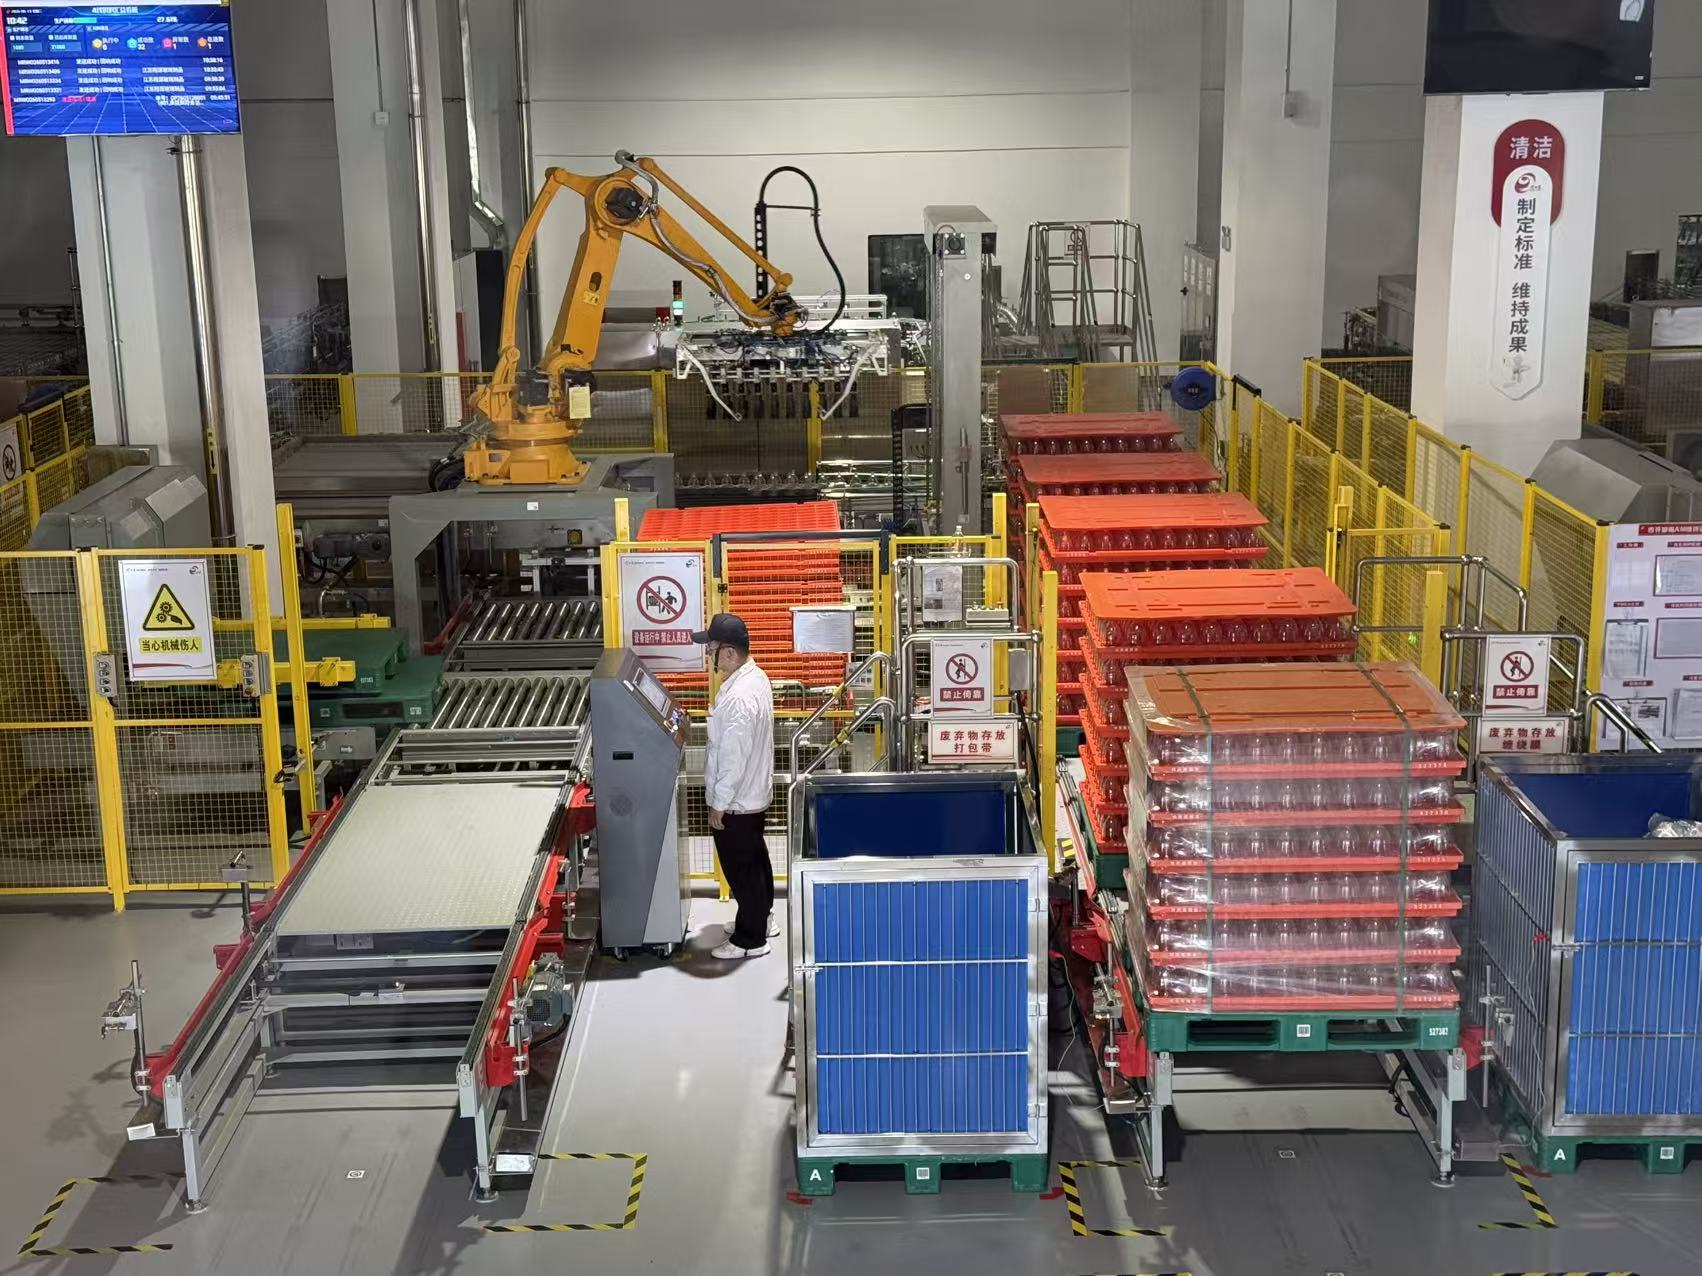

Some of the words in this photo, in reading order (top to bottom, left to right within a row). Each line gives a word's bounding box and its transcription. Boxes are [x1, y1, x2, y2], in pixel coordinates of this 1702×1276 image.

[1510, 135, 1553, 160] 清洁
[1513, 198, 1536, 270] 制定标准
[1508, 282, 1531, 353] 维持成果
[634, 631, 660, 644] 设备运行中
[661, 631, 692, 643] 禁止人员进入
[142, 639, 199, 651] 当心机械伤人
[942, 689, 982, 699] 禁止倚靠
[1495, 687, 1536, 697] 禁止倚靠
[940, 730, 1006, 741] 废弃物存放
[1488, 727, 1556, 738] 废弃物存放
[954, 743, 992, 753] 打包带
[1553, 1149, 1566, 1161] A
[809, 1169, 822, 1181] A
